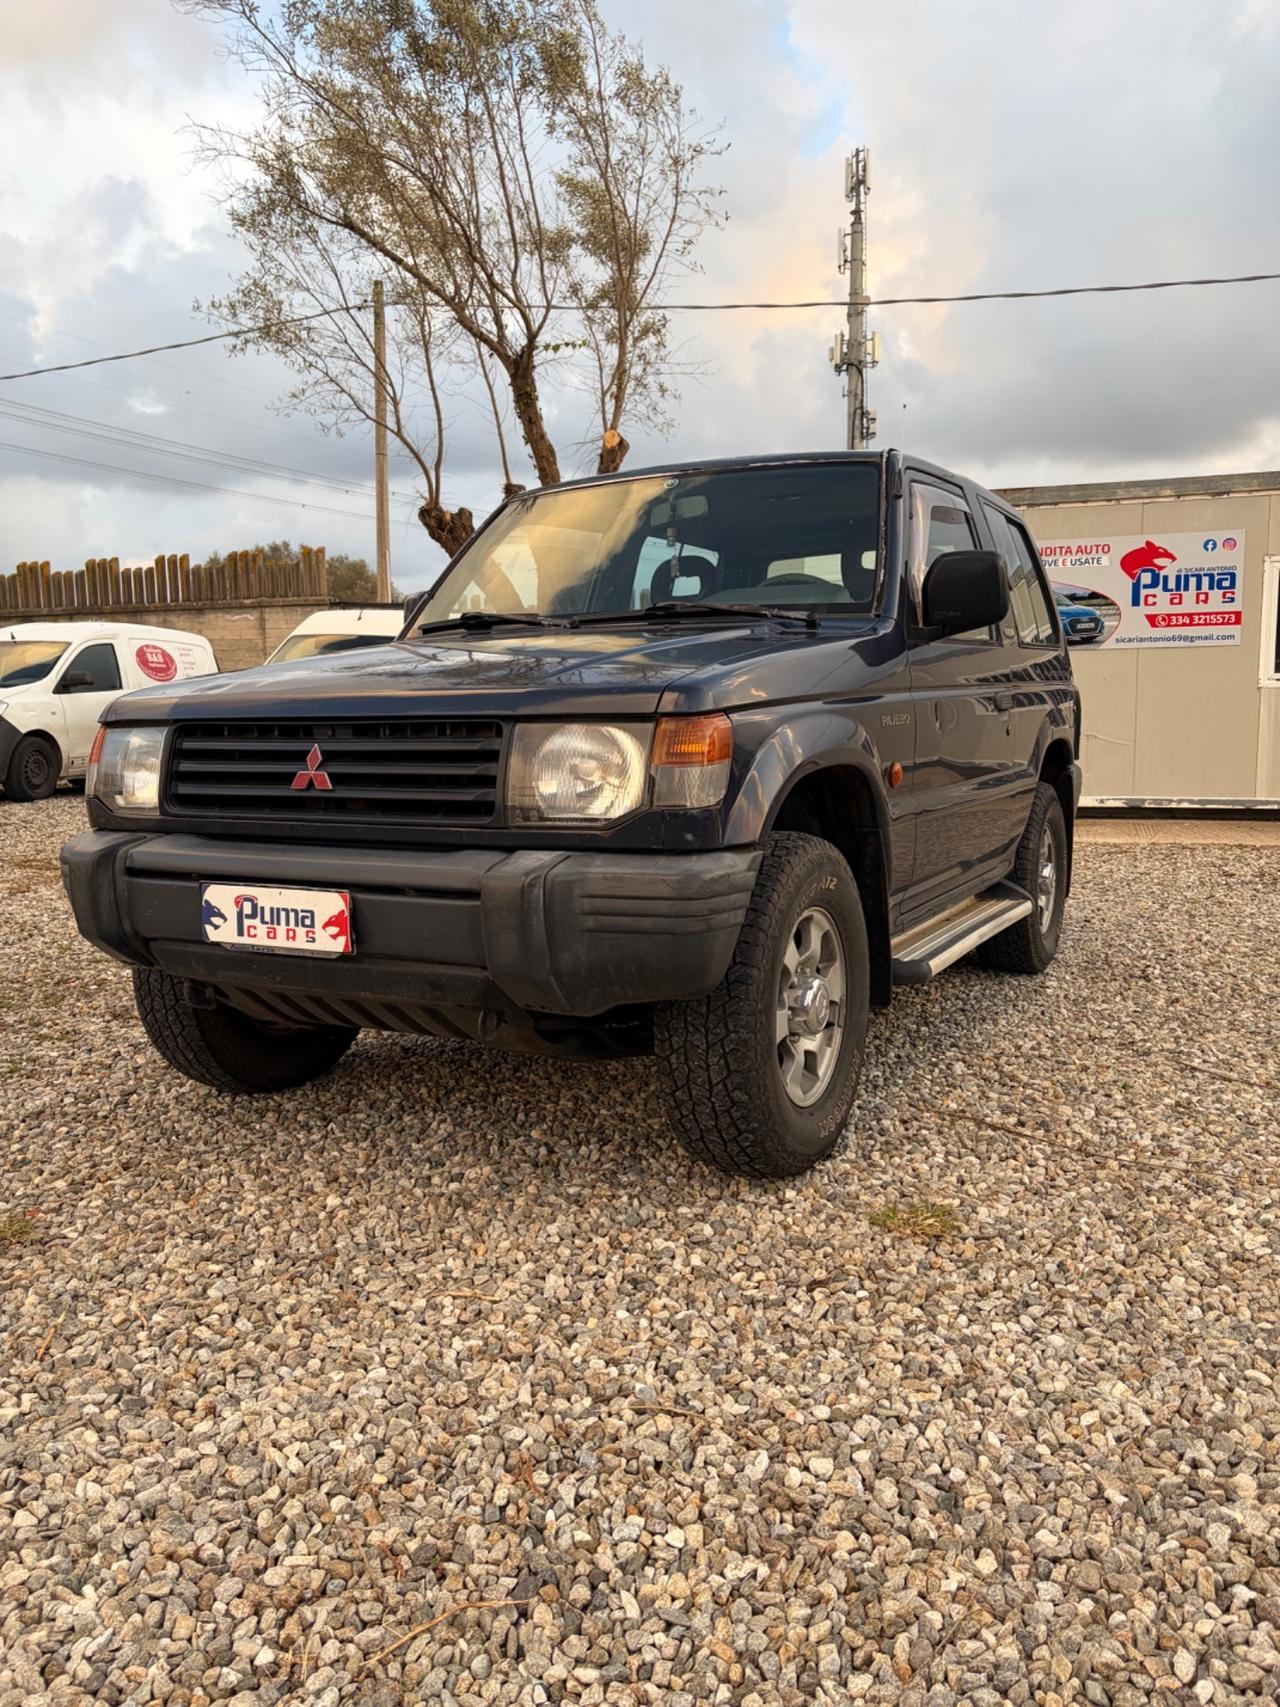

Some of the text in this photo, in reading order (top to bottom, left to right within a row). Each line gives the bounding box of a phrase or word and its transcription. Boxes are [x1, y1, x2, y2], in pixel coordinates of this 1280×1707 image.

[1075, 544, 1111, 555] AUTO
[1062, 558, 1068, 567] E
[1070, 556, 1103, 567] USATE
[1131, 568, 1236, 607] Puma
[1170, 614, 1236, 625] 334 3215573
[1115, 633, 1235, 644] sicariantonio69@gmail.com
[882, 713, 911, 727] PAJERO
[236, 896, 315, 937] Puma
